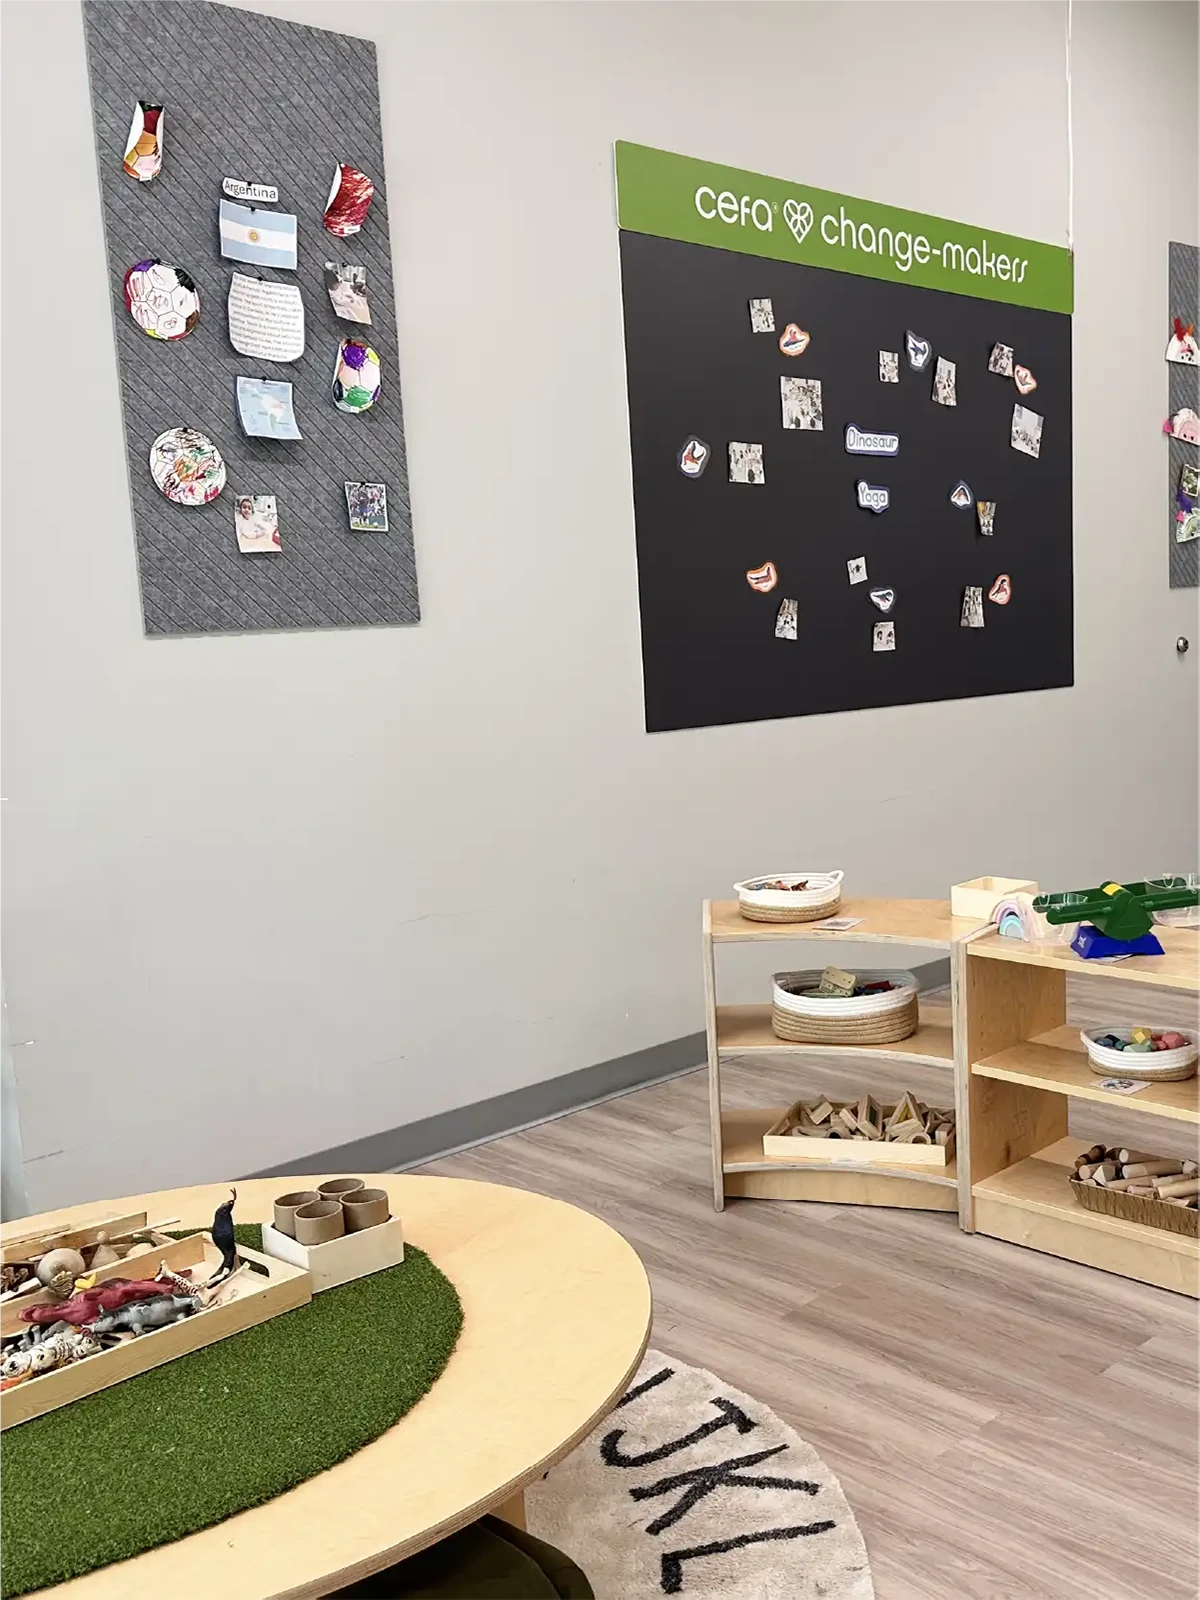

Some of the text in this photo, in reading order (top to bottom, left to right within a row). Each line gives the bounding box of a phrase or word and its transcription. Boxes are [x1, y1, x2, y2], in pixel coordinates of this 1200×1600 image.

[225, 180, 276, 199] Argentina
[820, 206, 1029, 284] change-makers
[848, 429, 897, 449] Dinosaur
[860, 485, 886, 507] Yoga
